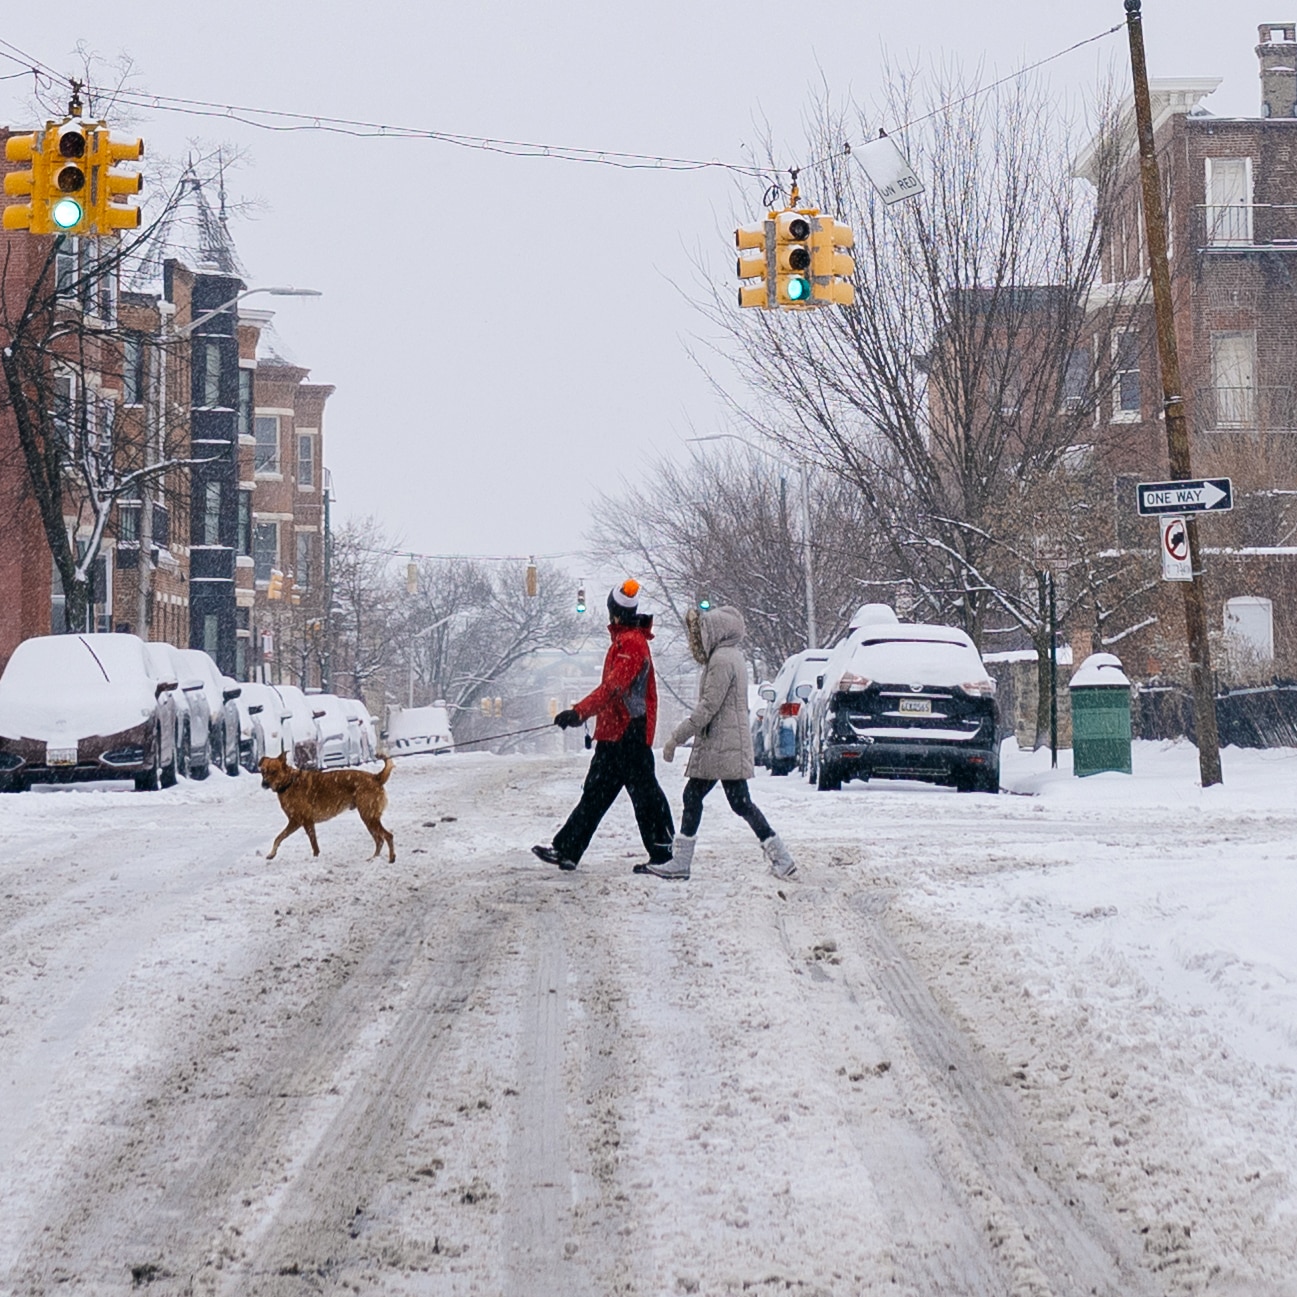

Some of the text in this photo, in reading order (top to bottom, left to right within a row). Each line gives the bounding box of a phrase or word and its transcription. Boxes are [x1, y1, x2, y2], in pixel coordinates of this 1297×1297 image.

[897, 175, 918, 191] RED
[1146, 490, 1202, 505] ONE WAY
